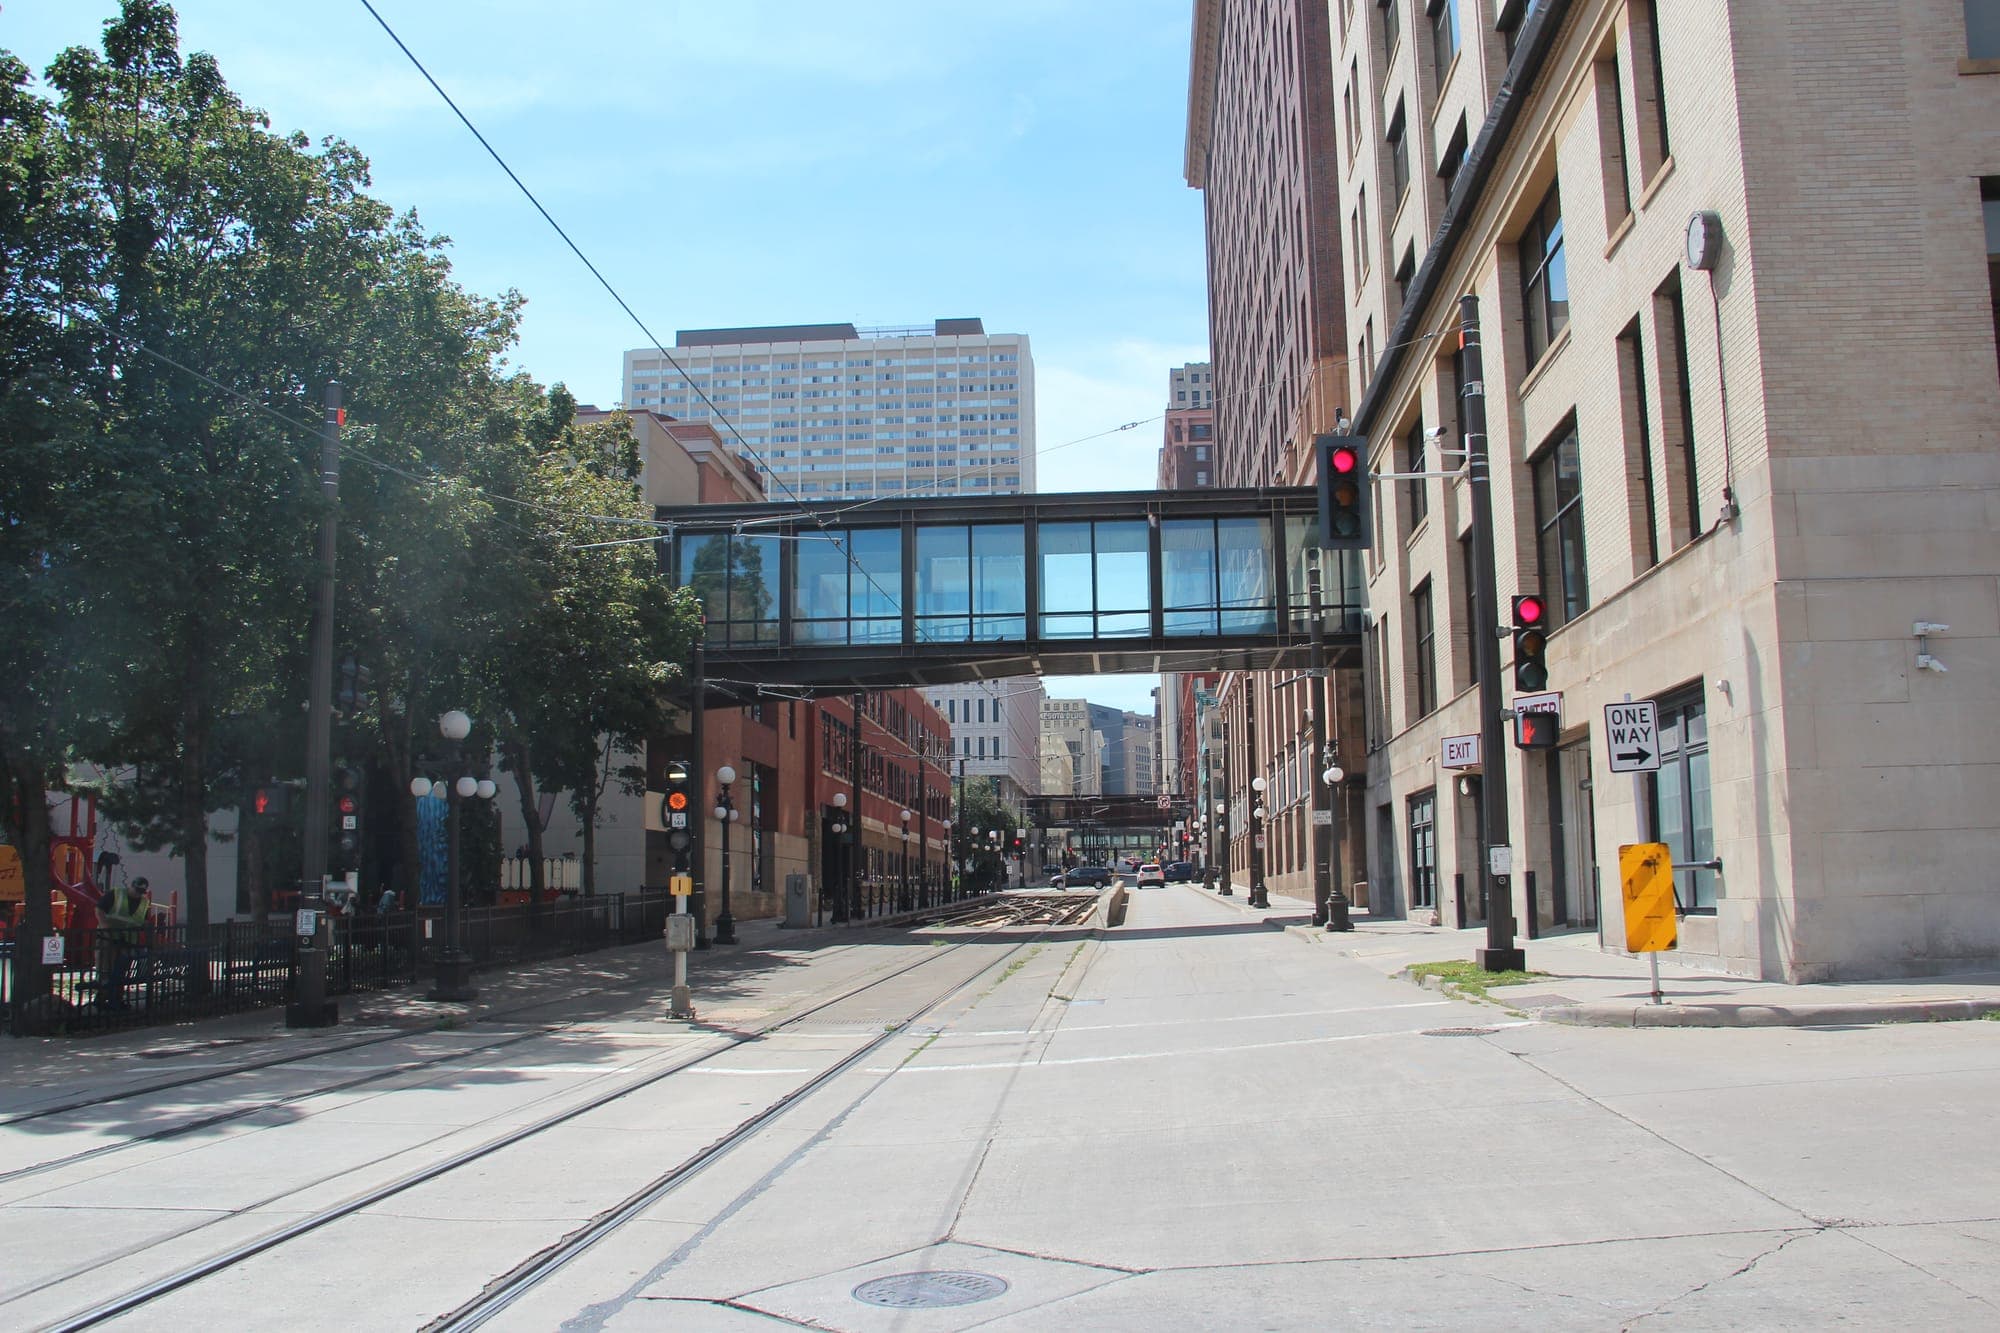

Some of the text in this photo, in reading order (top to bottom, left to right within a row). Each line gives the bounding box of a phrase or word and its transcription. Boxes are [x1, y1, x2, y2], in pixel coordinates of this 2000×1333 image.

[1611, 708, 1650, 725] ONE
[1612, 726, 1652, 744] WAY
[1448, 742, 1471, 760] EXIT
